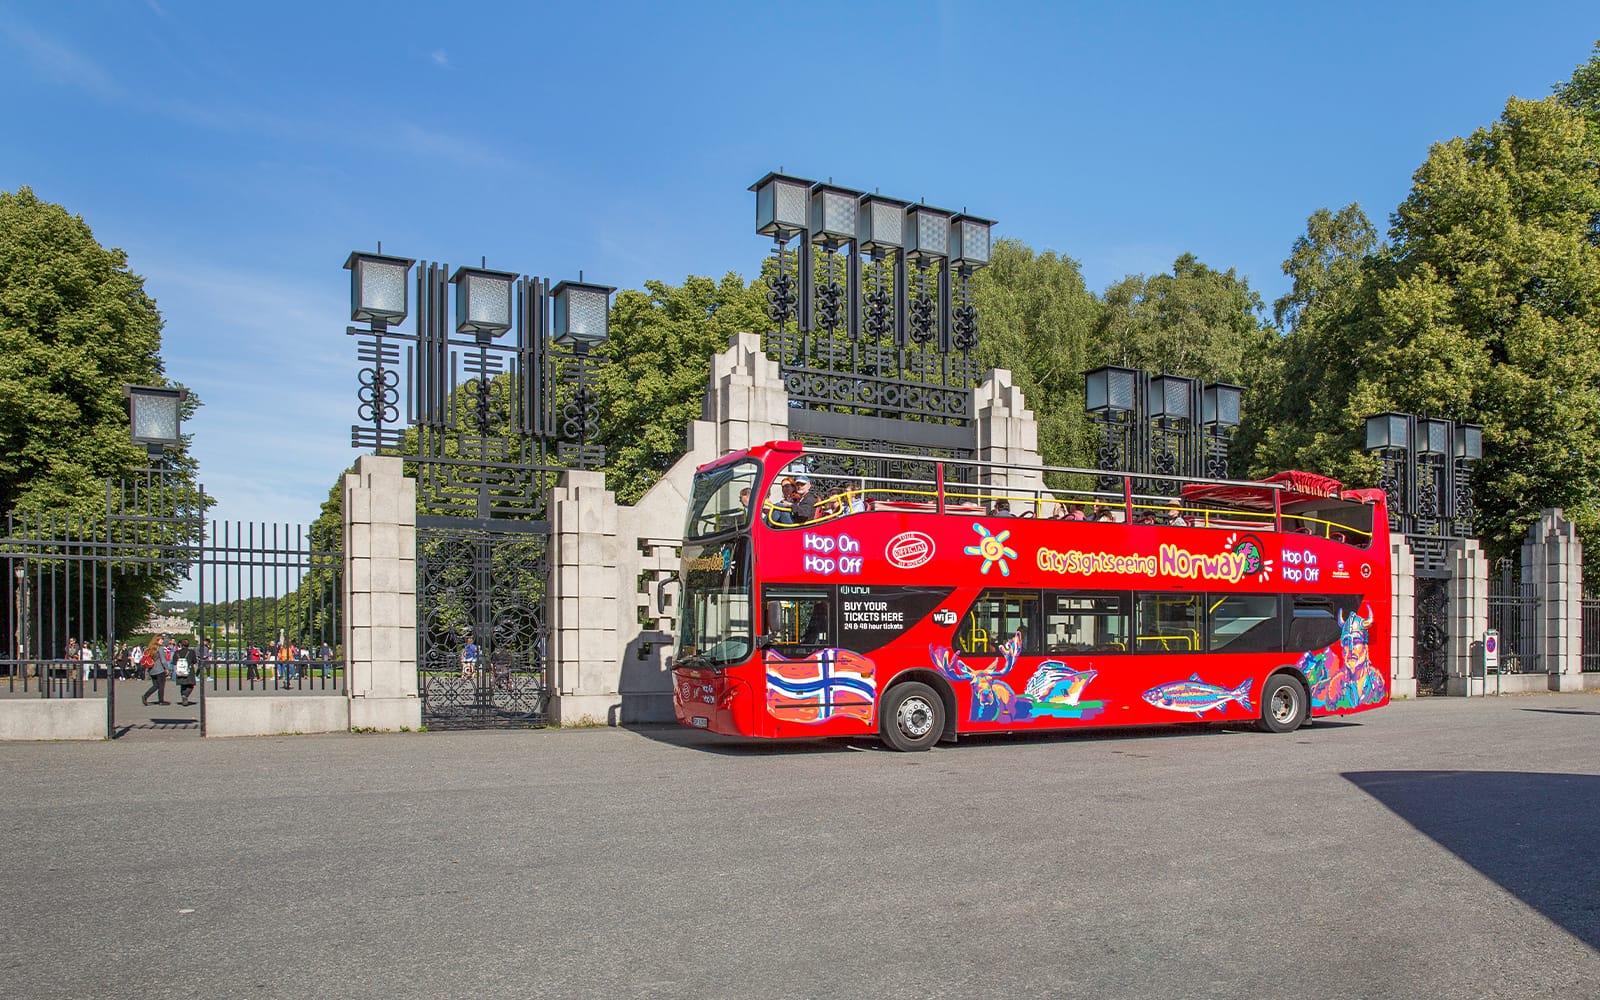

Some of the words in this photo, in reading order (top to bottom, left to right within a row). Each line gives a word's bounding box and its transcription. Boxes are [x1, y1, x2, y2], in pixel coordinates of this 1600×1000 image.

[804, 534, 835, 552] Hop
[838, 535, 859, 552] On
[804, 556, 835, 574] Hop
[839, 557, 863, 573] Off
[1282, 550, 1301, 565] Hop
[1303, 550, 1317, 564] On
[1283, 567, 1302, 582] Hop
[1304, 567, 1319, 581] Off
[844, 601, 862, 611] BUY
[863, 601, 887, 611] YOUR
[844, 612, 880, 622] TICKETS
[881, 612, 904, 622] HERE
[844, 622, 853, 630] 24
[859, 622, 868, 630] 48
[868, 622, 882, 630] hour
[883, 622, 904, 630] tickets
